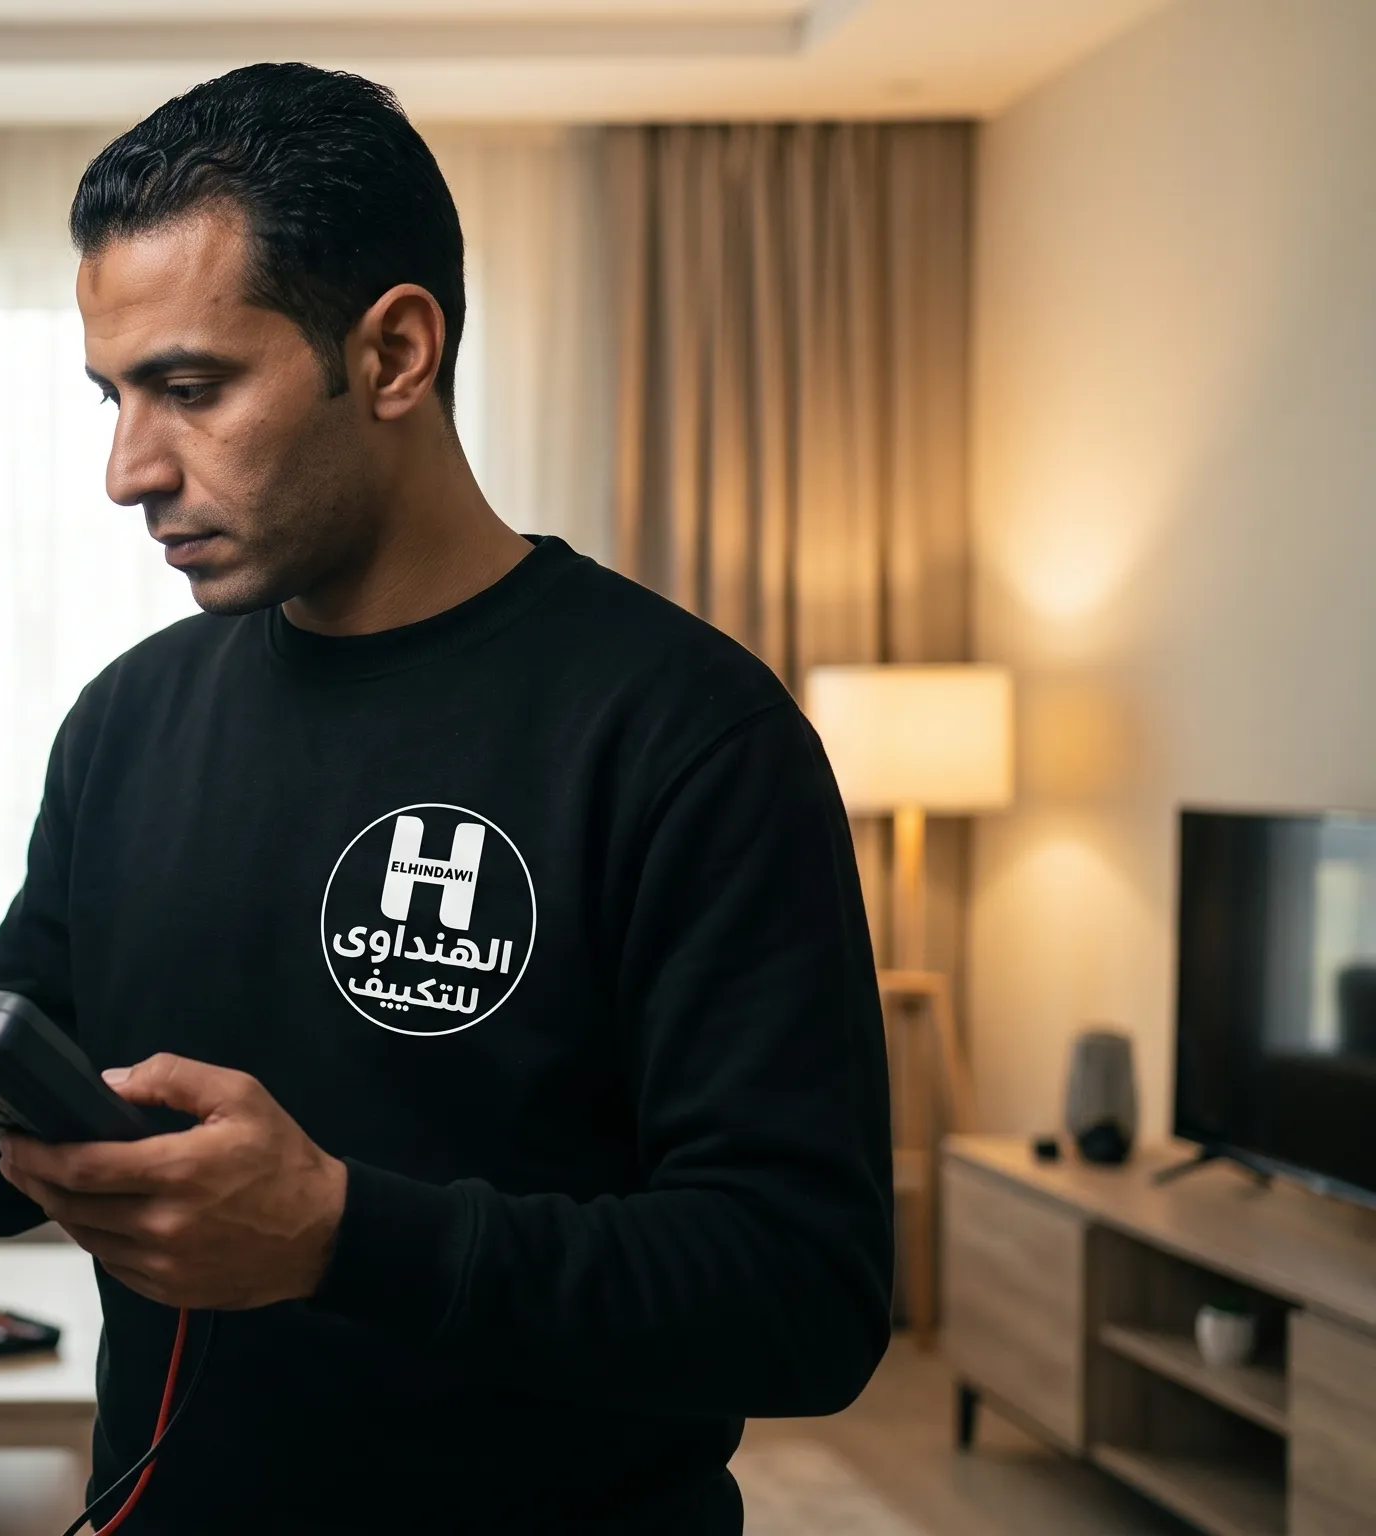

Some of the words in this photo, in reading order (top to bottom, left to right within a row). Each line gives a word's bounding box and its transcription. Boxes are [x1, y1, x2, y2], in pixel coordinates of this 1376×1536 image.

[381, 816, 485, 930] H
[391, 861, 473, 882] ELHINDAWI
[333, 925, 513, 974] الهنداوى
[348, 969, 479, 1014] للتكييف
